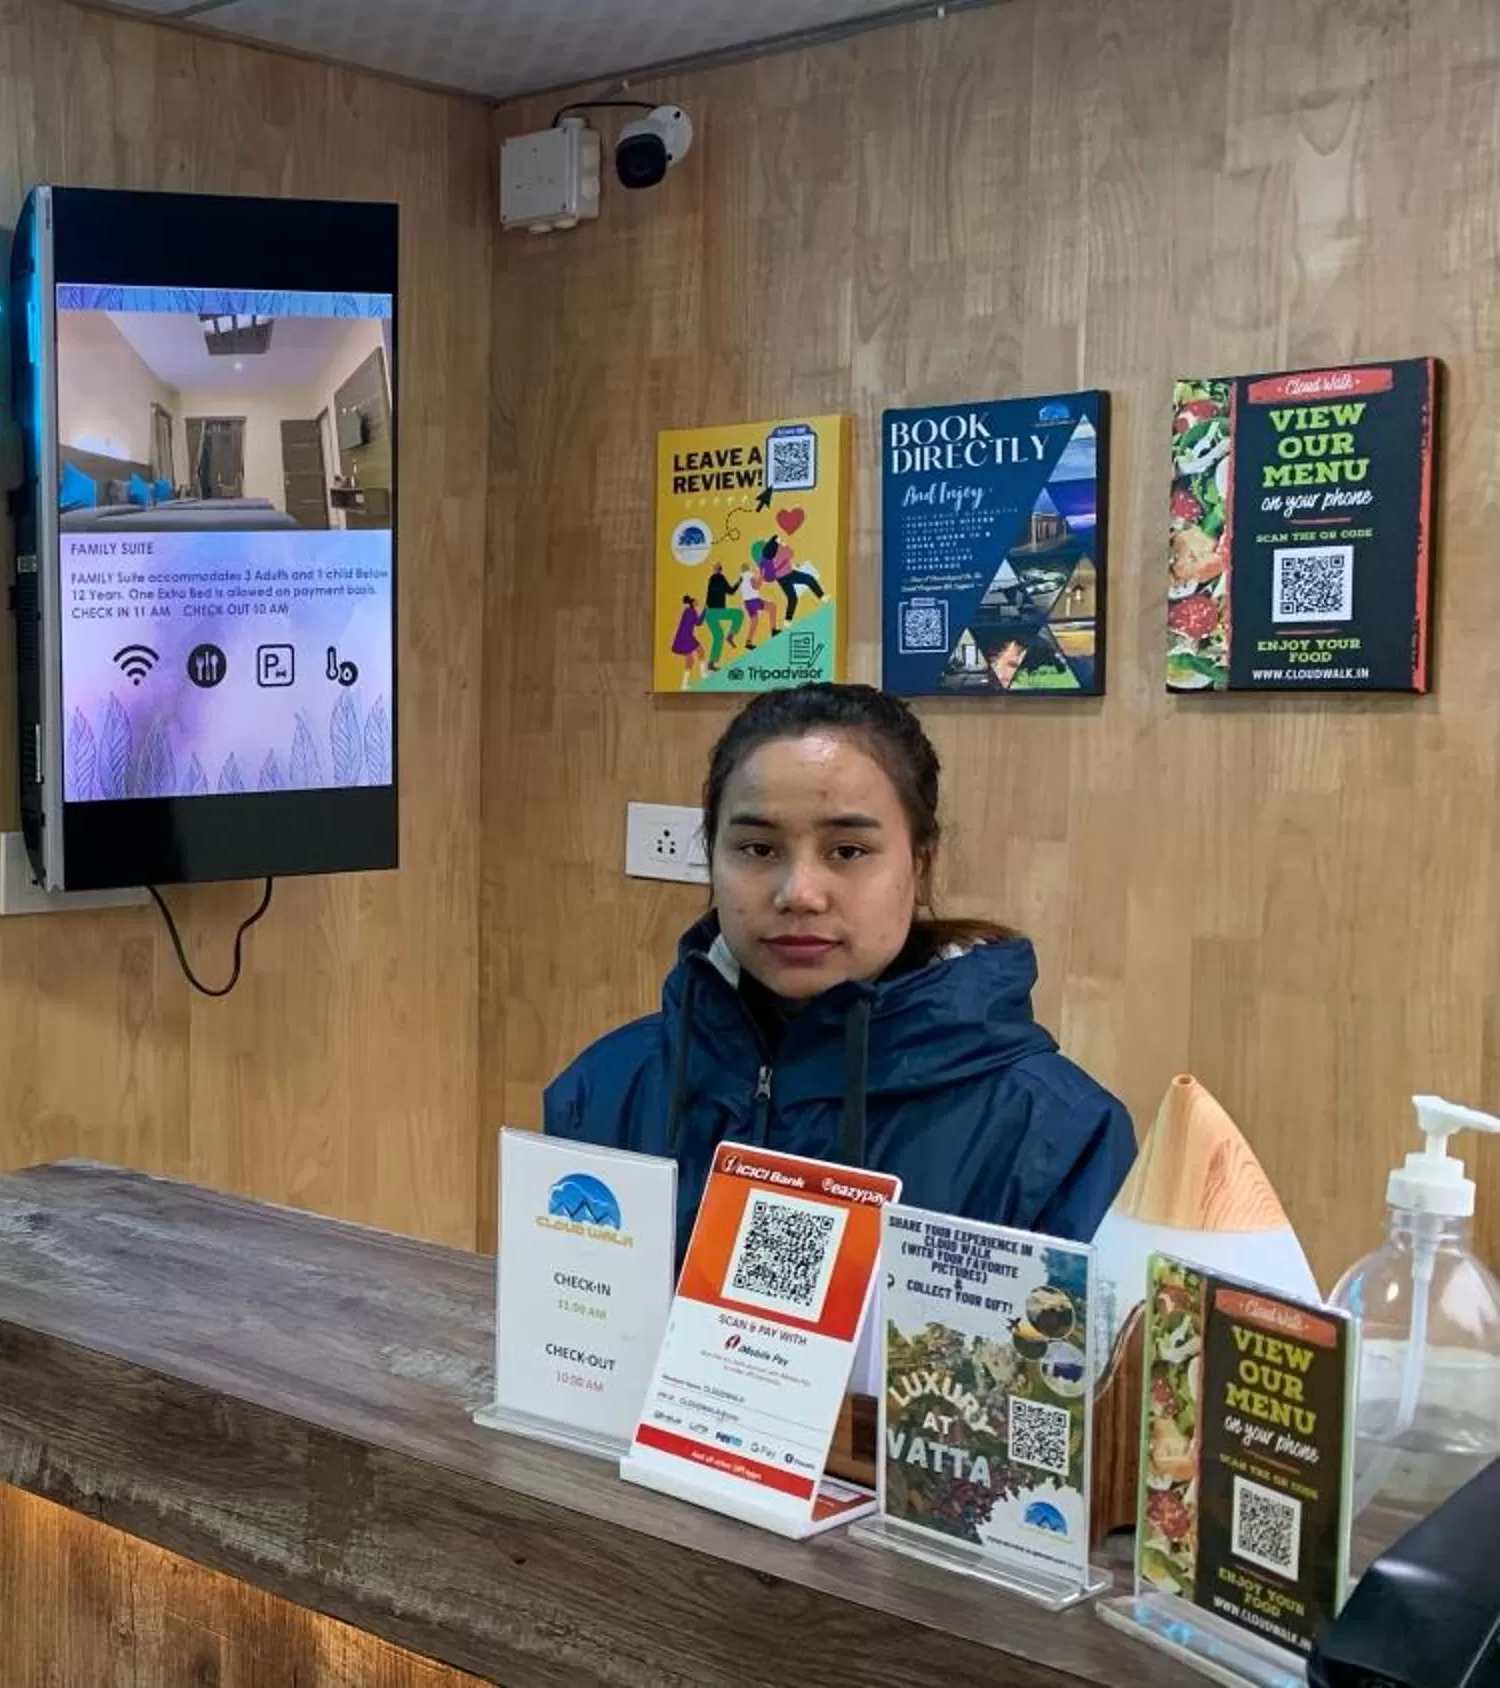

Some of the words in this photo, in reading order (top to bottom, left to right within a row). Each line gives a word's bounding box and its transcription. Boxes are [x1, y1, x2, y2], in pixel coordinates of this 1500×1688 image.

[890, 412, 991, 448] BOOK
[1268, 402, 1367, 432] VIEW
[673, 447, 743, 472] LEAVE
[747, 445, 763, 465] A
[891, 434, 1050, 475] DIRECTLY
[1277, 431, 1355, 459] OUR
[673, 468, 763, 495] REVIEW!
[1261, 458, 1371, 488] MENU
[902, 483, 938, 508] And
[1260, 495, 1283, 512] on
[1283, 493, 1321, 518] your
[1321, 487, 1374, 512] phone
[70, 542, 116, 556] FAMILY
[121, 541, 154, 555] SUITE
[1255, 533, 1288, 543] SCAN
[1291, 531, 1317, 541] THE
[1340, 528, 1374, 539] CODE
[71, 571, 114, 585] FAMILY
[291, 568, 314, 581] and
[325, 567, 353, 580] child
[71, 589, 85, 601] 12
[128, 588, 154, 600] One
[157, 587, 186, 599] Extra
[189, 586, 212, 599] Bed
[227, 585, 273, 598] allowed
[275, 587, 290, 597] on
[293, 584, 345, 600] payment
[71, 606, 114, 619] CHECK
[117, 606, 129, 618] IN
[134, 605, 145, 617] 11
[149, 605, 171, 617] AM
[182, 604, 224, 617] CHECK
[227, 603, 250, 615] OUT
[254, 603, 267, 615] 10
[269, 603, 289, 615] AM
[1257, 639, 1311, 652] ENJOY
[1315, 637, 1361, 649] YOUR
[1288, 651, 1333, 664] FOOD
[747, 665, 824, 681] Tripadvisor
[770, 1171, 805, 1189] Bank
[924, 1223, 951, 1239] YOUR
[953, 1229, 1020, 1255] EXPERIENCE
[1021, 1243, 1034, 1257] IN
[924, 1235, 958, 1253] CLOUD
[960, 1243, 992, 1260] WALK
[966, 1256, 1020, 1279] FAVORITE
[906, 1279, 952, 1300] COLLECT
[955, 1291, 982, 1308] YOUR
[718, 1312, 748, 1330] SCAN
[757, 1325, 779, 1339] PAY
[779, 1330, 808, 1345] WITH
[1231, 1324, 1315, 1375] VIEW
[1239, 1359, 1305, 1402] OUR
[888, 1371, 998, 1437] LUXURY
[1224, 1381, 1317, 1435] MENU
[922, 1411, 953, 1435] AT
[1223, 1415, 1243, 1435] on
[1242, 1422, 1275, 1447] your
[1274, 1432, 1320, 1464] phone
[887, 1428, 992, 1489] VATTA
[1218, 1567, 1263, 1596] ENJOY
[1266, 1589, 1305, 1617] YOUR
[1243, 1592, 1281, 1618] FOOD
